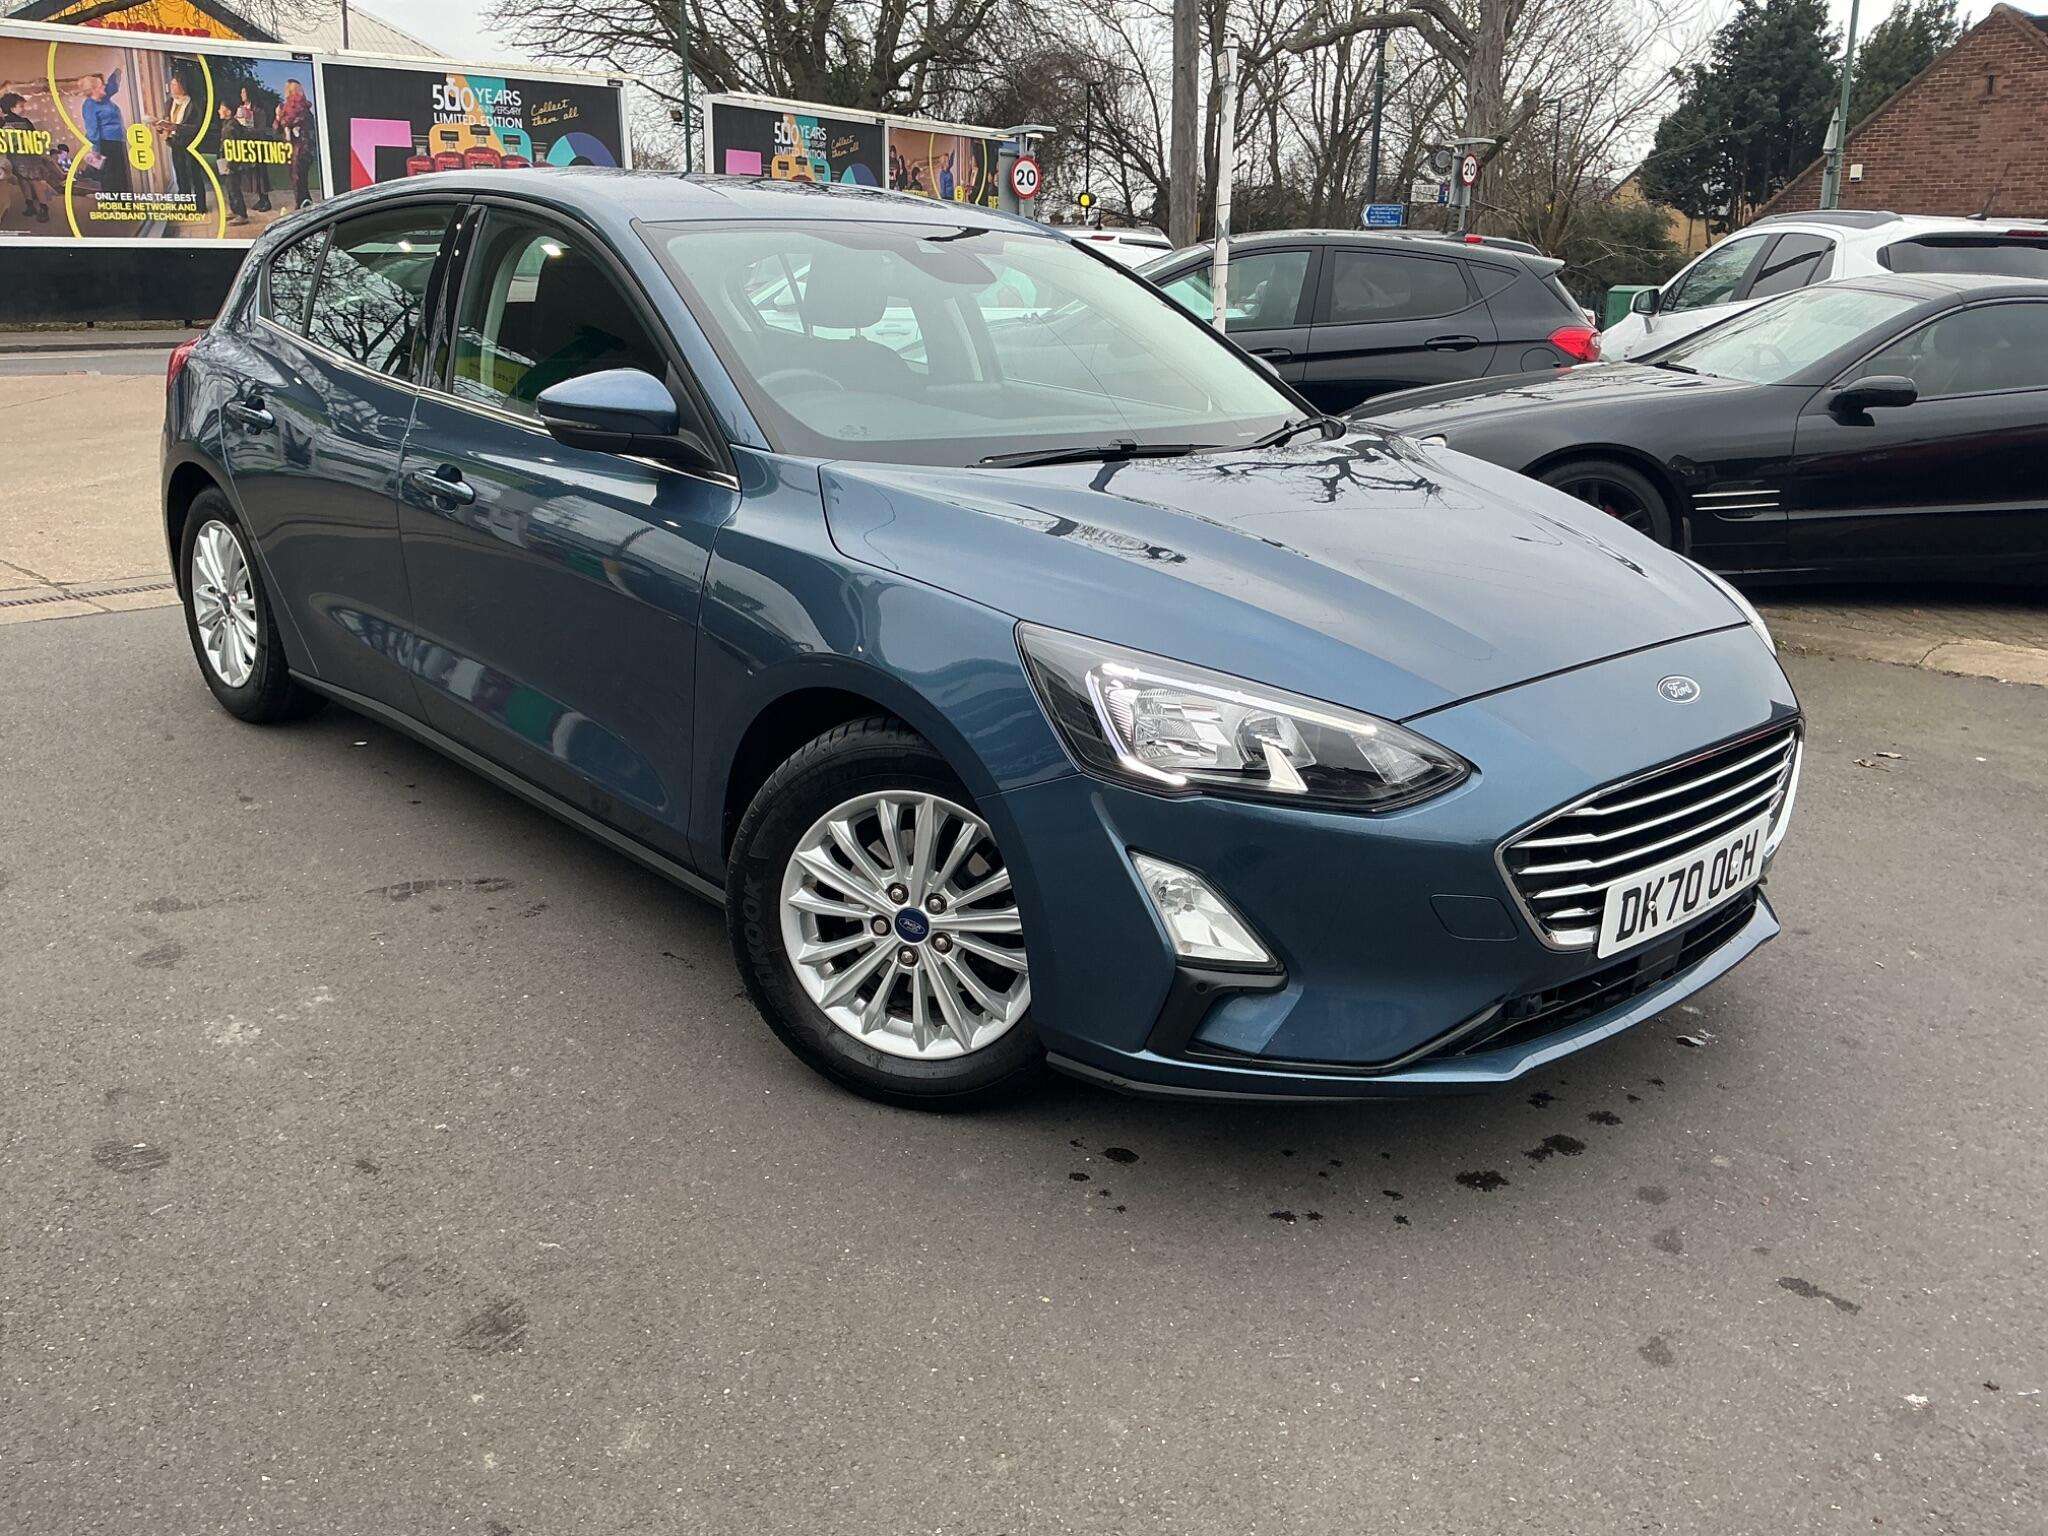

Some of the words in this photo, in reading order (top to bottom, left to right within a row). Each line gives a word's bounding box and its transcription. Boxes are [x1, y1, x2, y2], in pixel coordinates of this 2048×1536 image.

[432, 83, 475, 112] 500
[475, 87, 522, 107] YEARS
[530, 98, 570, 117] Collect
[433, 112, 477, 126] LIMITED
[480, 115, 523, 129] EDITION
[531, 115, 560, 127] them
[563, 106, 580, 120] all
[799, 125, 827, 141] YEARS
[223, 139, 293, 164] GUESTING?
[1016, 169, 1036, 186] 20
[1464, 163, 1476, 176] 20
[94, 192, 119, 201] ONLY
[120, 192, 133, 201] EE
[134, 192, 153, 201] HAS
[153, 193, 174, 202] THE
[174, 193, 197, 202] BEST
[97, 202, 132, 211] MOBILE
[132, 202, 178, 212] NETWORK
[178, 203, 197, 212] AND
[89, 211, 147, 220] BROADBAND
[147, 212, 207, 221] TECHNOLOGY
[1667, 681, 1692, 698] Ford
[1615, 859, 1704, 943] DK70
[1709, 828, 1759, 900] OCH
